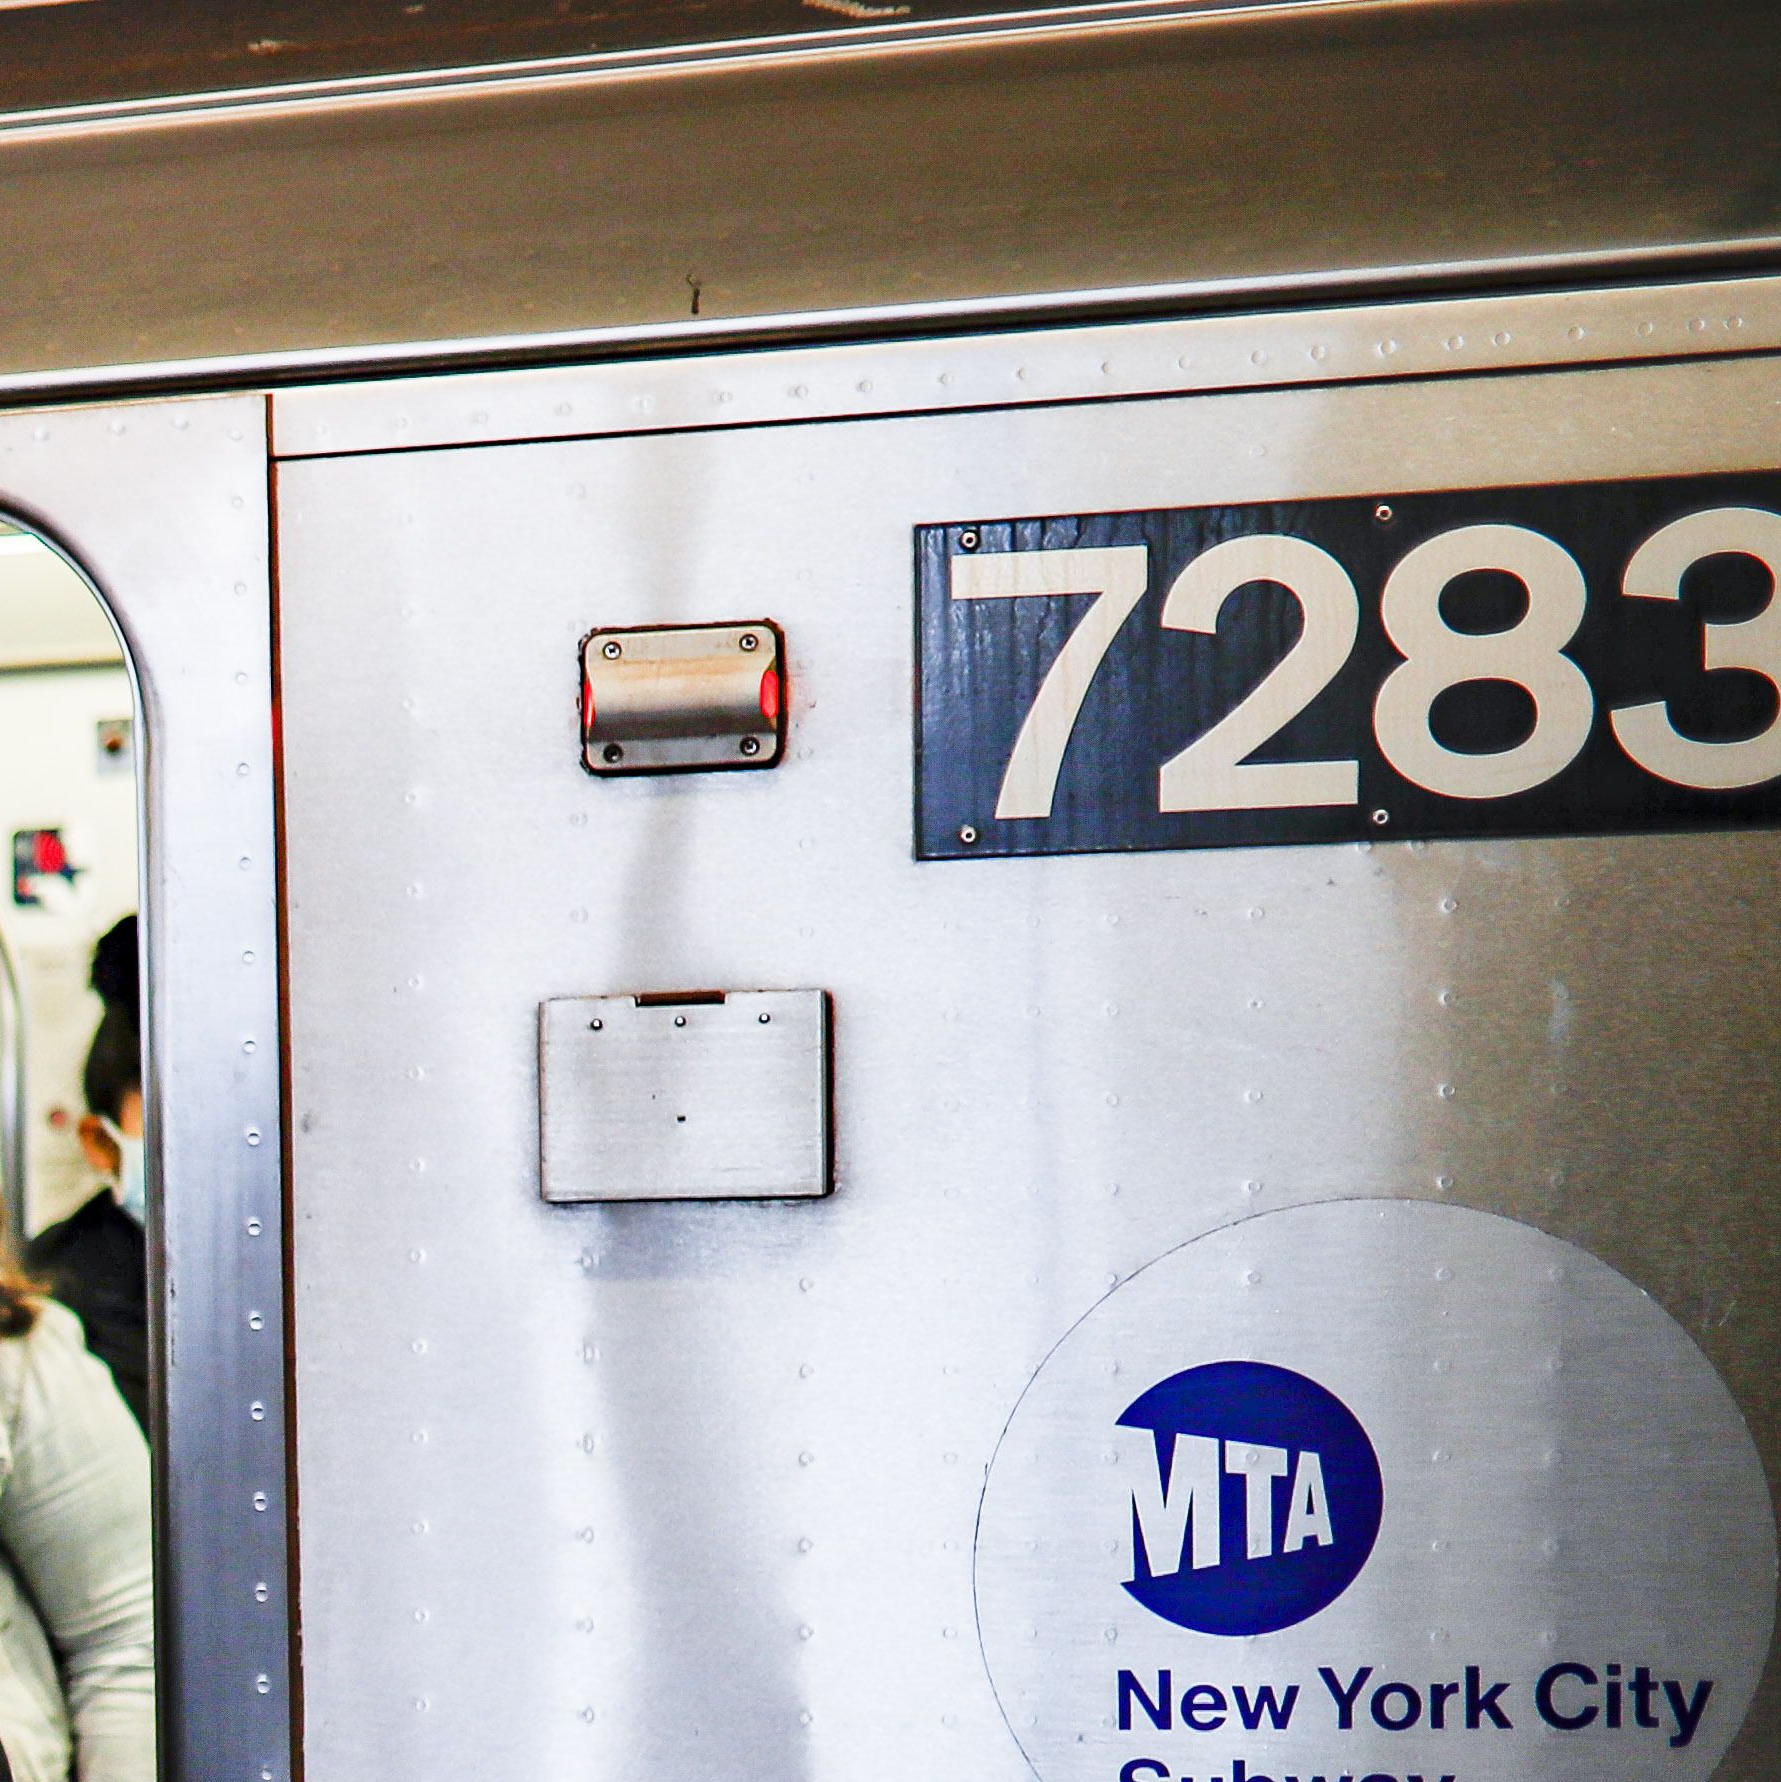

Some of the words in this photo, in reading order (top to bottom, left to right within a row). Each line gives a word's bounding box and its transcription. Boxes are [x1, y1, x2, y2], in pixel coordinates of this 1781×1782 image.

[949, 506, 1781, 820] 7283
[1115, 1423, 1334, 1583] MTA
[1117, 1669, 1300, 1731] New
[1318, 1665, 1513, 1731] York
[1535, 1661, 1715, 1749] City
